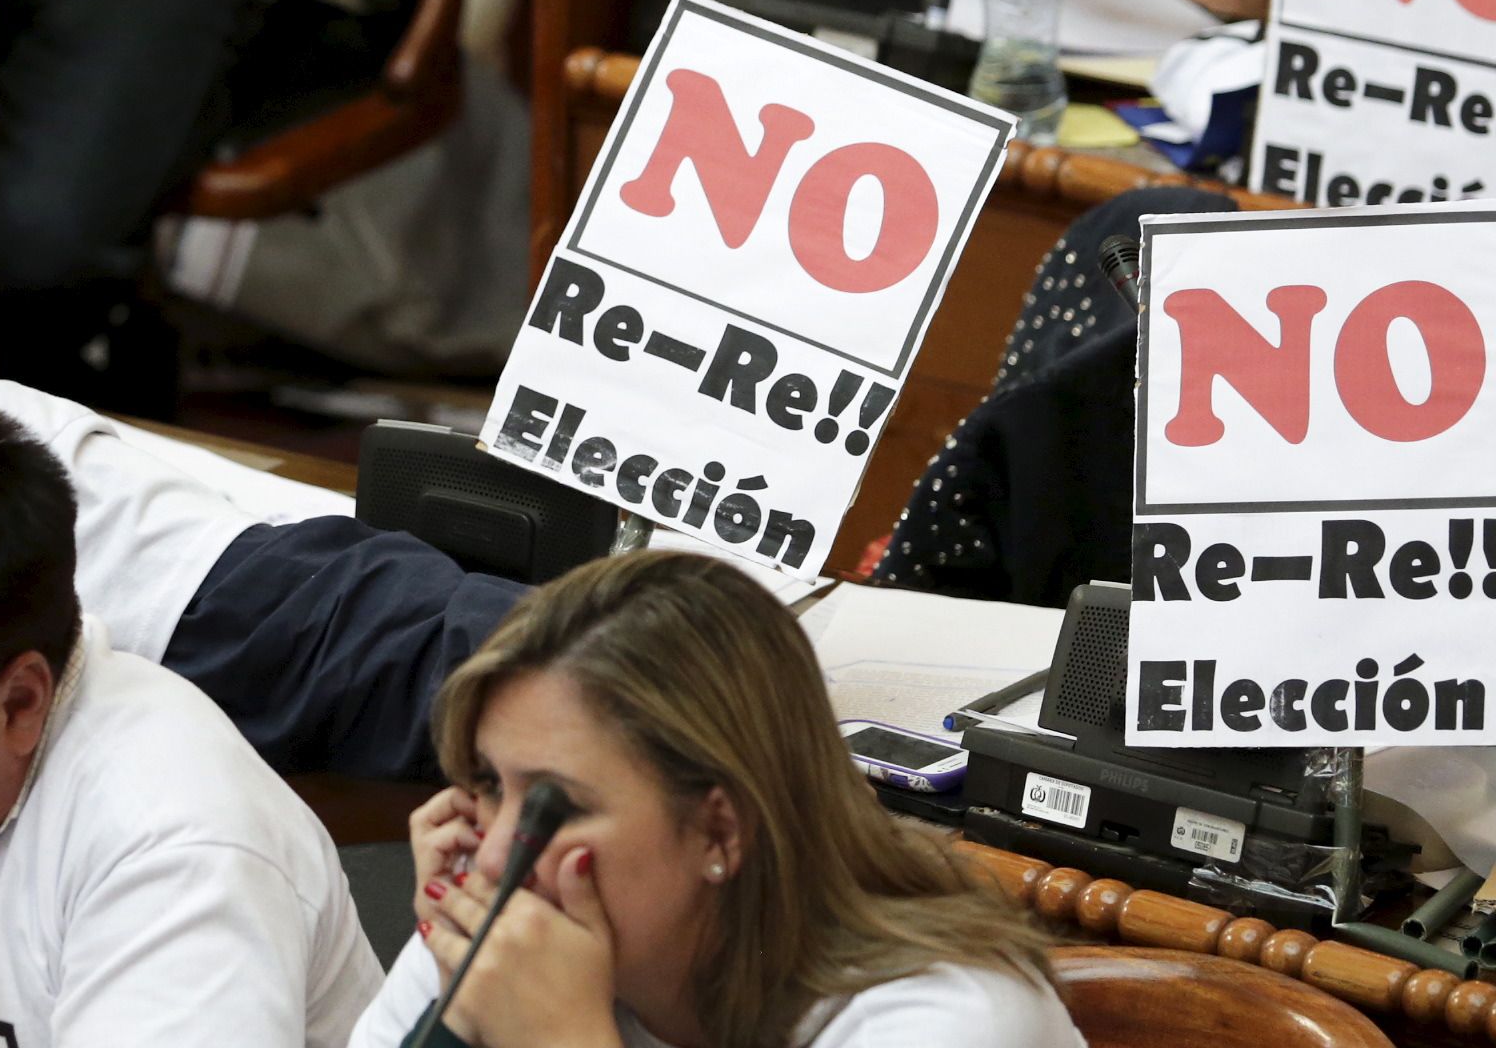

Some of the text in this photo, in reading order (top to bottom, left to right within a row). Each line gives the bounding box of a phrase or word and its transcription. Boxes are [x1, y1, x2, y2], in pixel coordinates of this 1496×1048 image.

[619, 68, 939, 293] NO
[528, 256, 896, 456] Re-Re!!
[1163, 280, 1486, 447] NO
[493, 384, 816, 570] Elección
[1137, 653, 1485, 732] Elección
